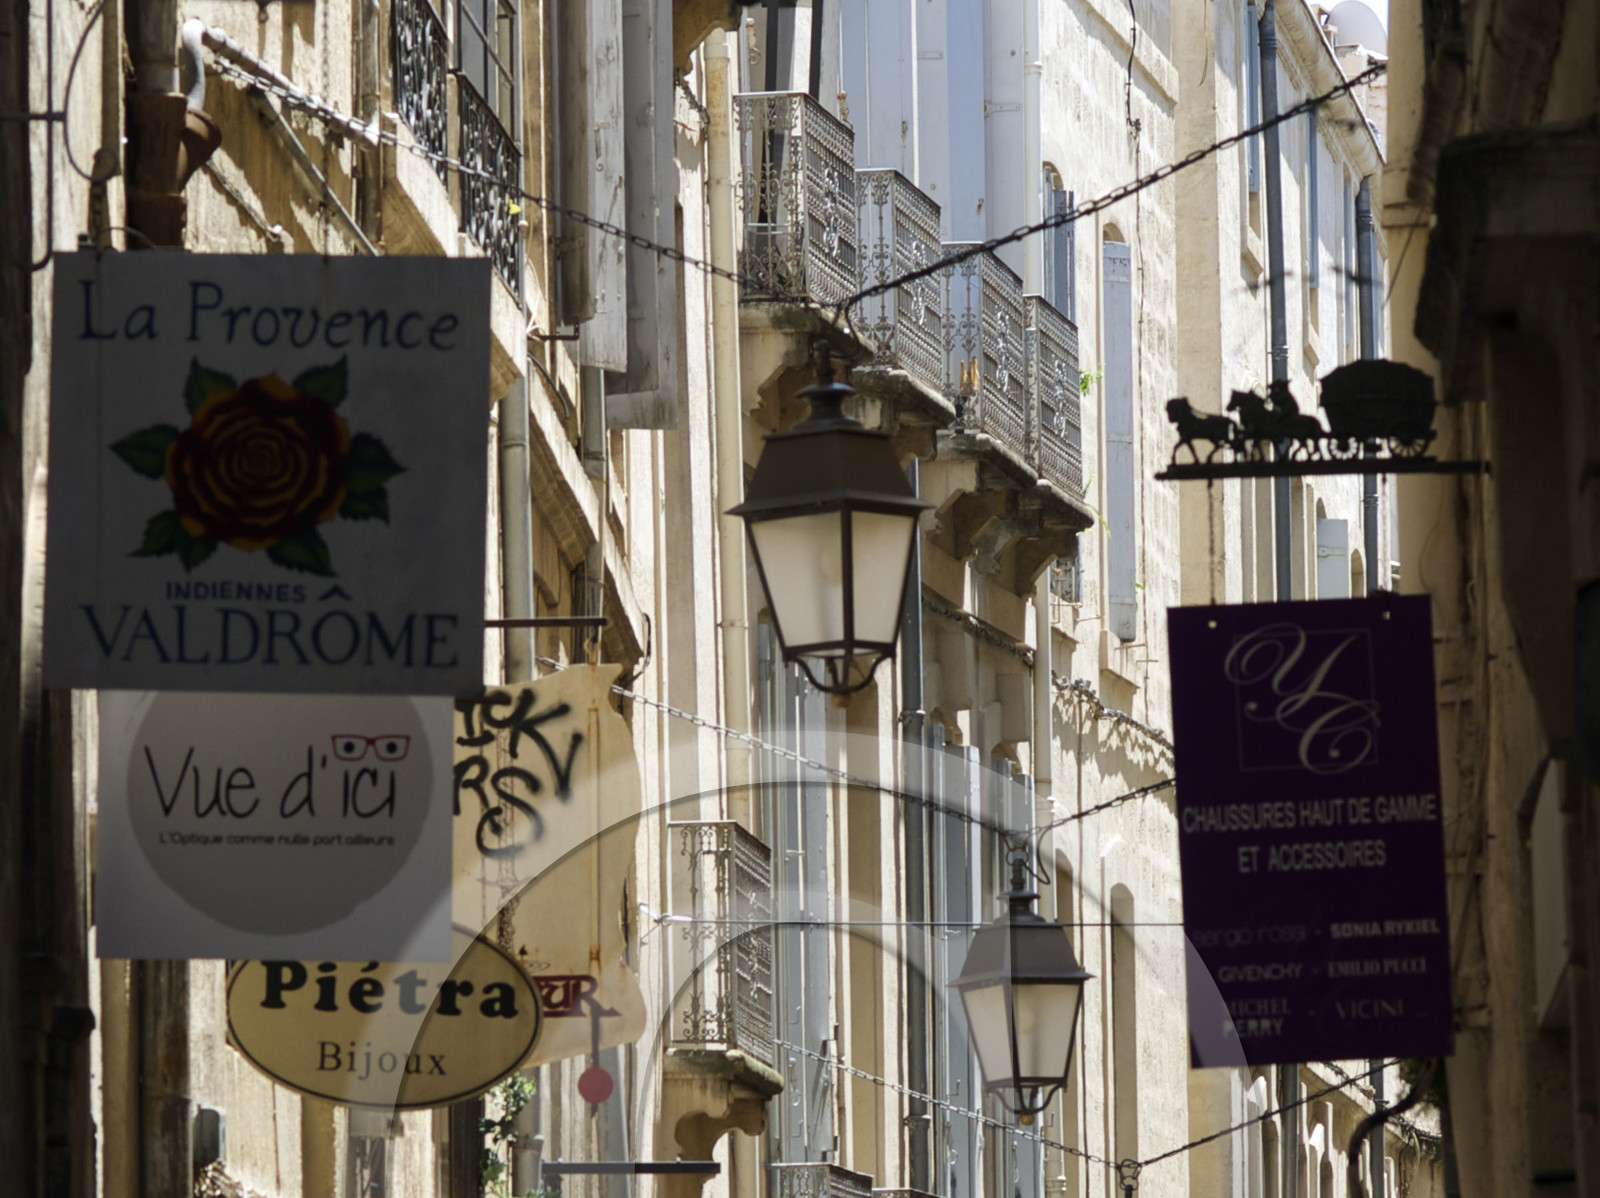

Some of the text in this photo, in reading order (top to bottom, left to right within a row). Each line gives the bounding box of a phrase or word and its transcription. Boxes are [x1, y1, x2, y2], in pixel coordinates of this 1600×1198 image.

[77, 279, 461, 351] La Provence
[165, 580, 307, 603] INDIENNES
[78, 583, 460, 669] VALDRÔME
[143, 745, 260, 819] Vue
[1182, 794, 1438, 833] CHAUSSURES HAUT DE GAMME
[226, 833, 275, 845] comme
[313, 833, 342, 847] part
[1238, 839, 1387, 874] ET ACCESSOIRES
[1329, 921, 1381, 940] SONIA
[259, 960, 519, 1020] Piétra
[1218, 962, 1303, 984] GIVENCHY
[316, 1040, 447, 1081] Bijoux
